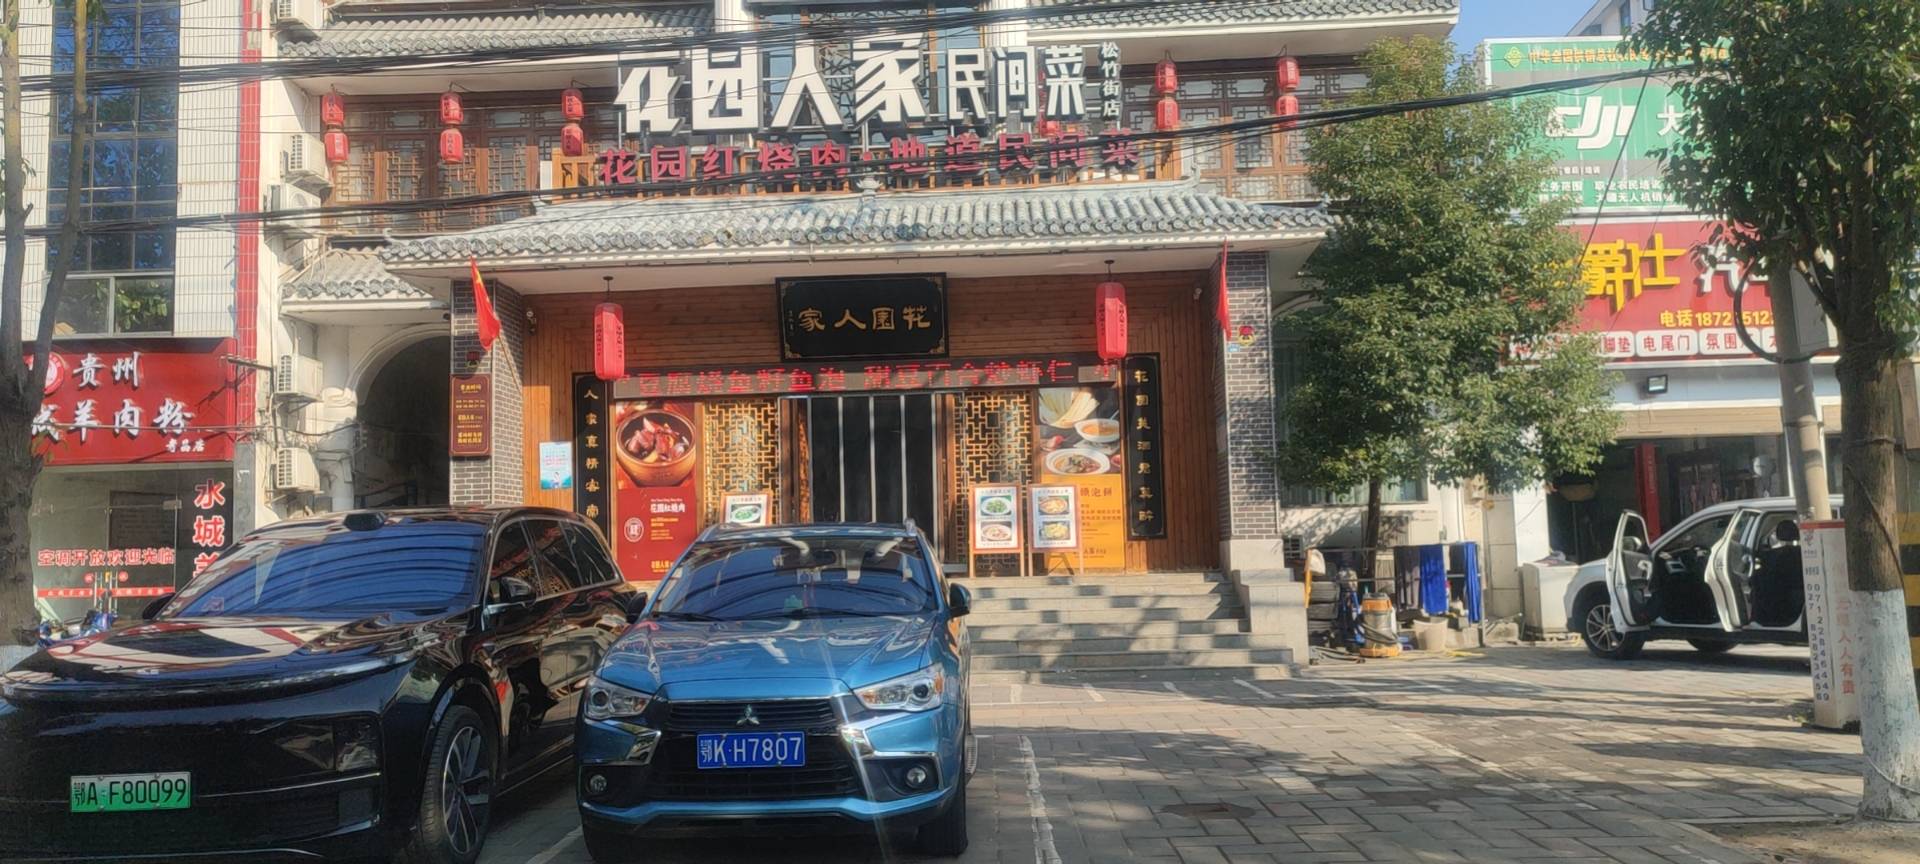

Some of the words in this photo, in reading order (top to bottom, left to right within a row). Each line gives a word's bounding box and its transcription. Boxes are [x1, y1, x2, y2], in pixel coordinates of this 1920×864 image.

[613, 34, 927, 133] 花园人家
[948, 46, 1083, 119] 民间菜
[1101, 42, 1119, 117] 松竹街店
[1546, 96, 1637, 149] DJI
[1661, 310, 1693, 327] 电话
[1696, 311, 1774, 326] 1872512
[1643, 334, 1690, 352] 电尾门
[73, 351, 142, 388] 贵州
[37, 548, 176, 567] 空调开放欢迎光临
[700, 737, 802, 763] 鄂K·H7807
